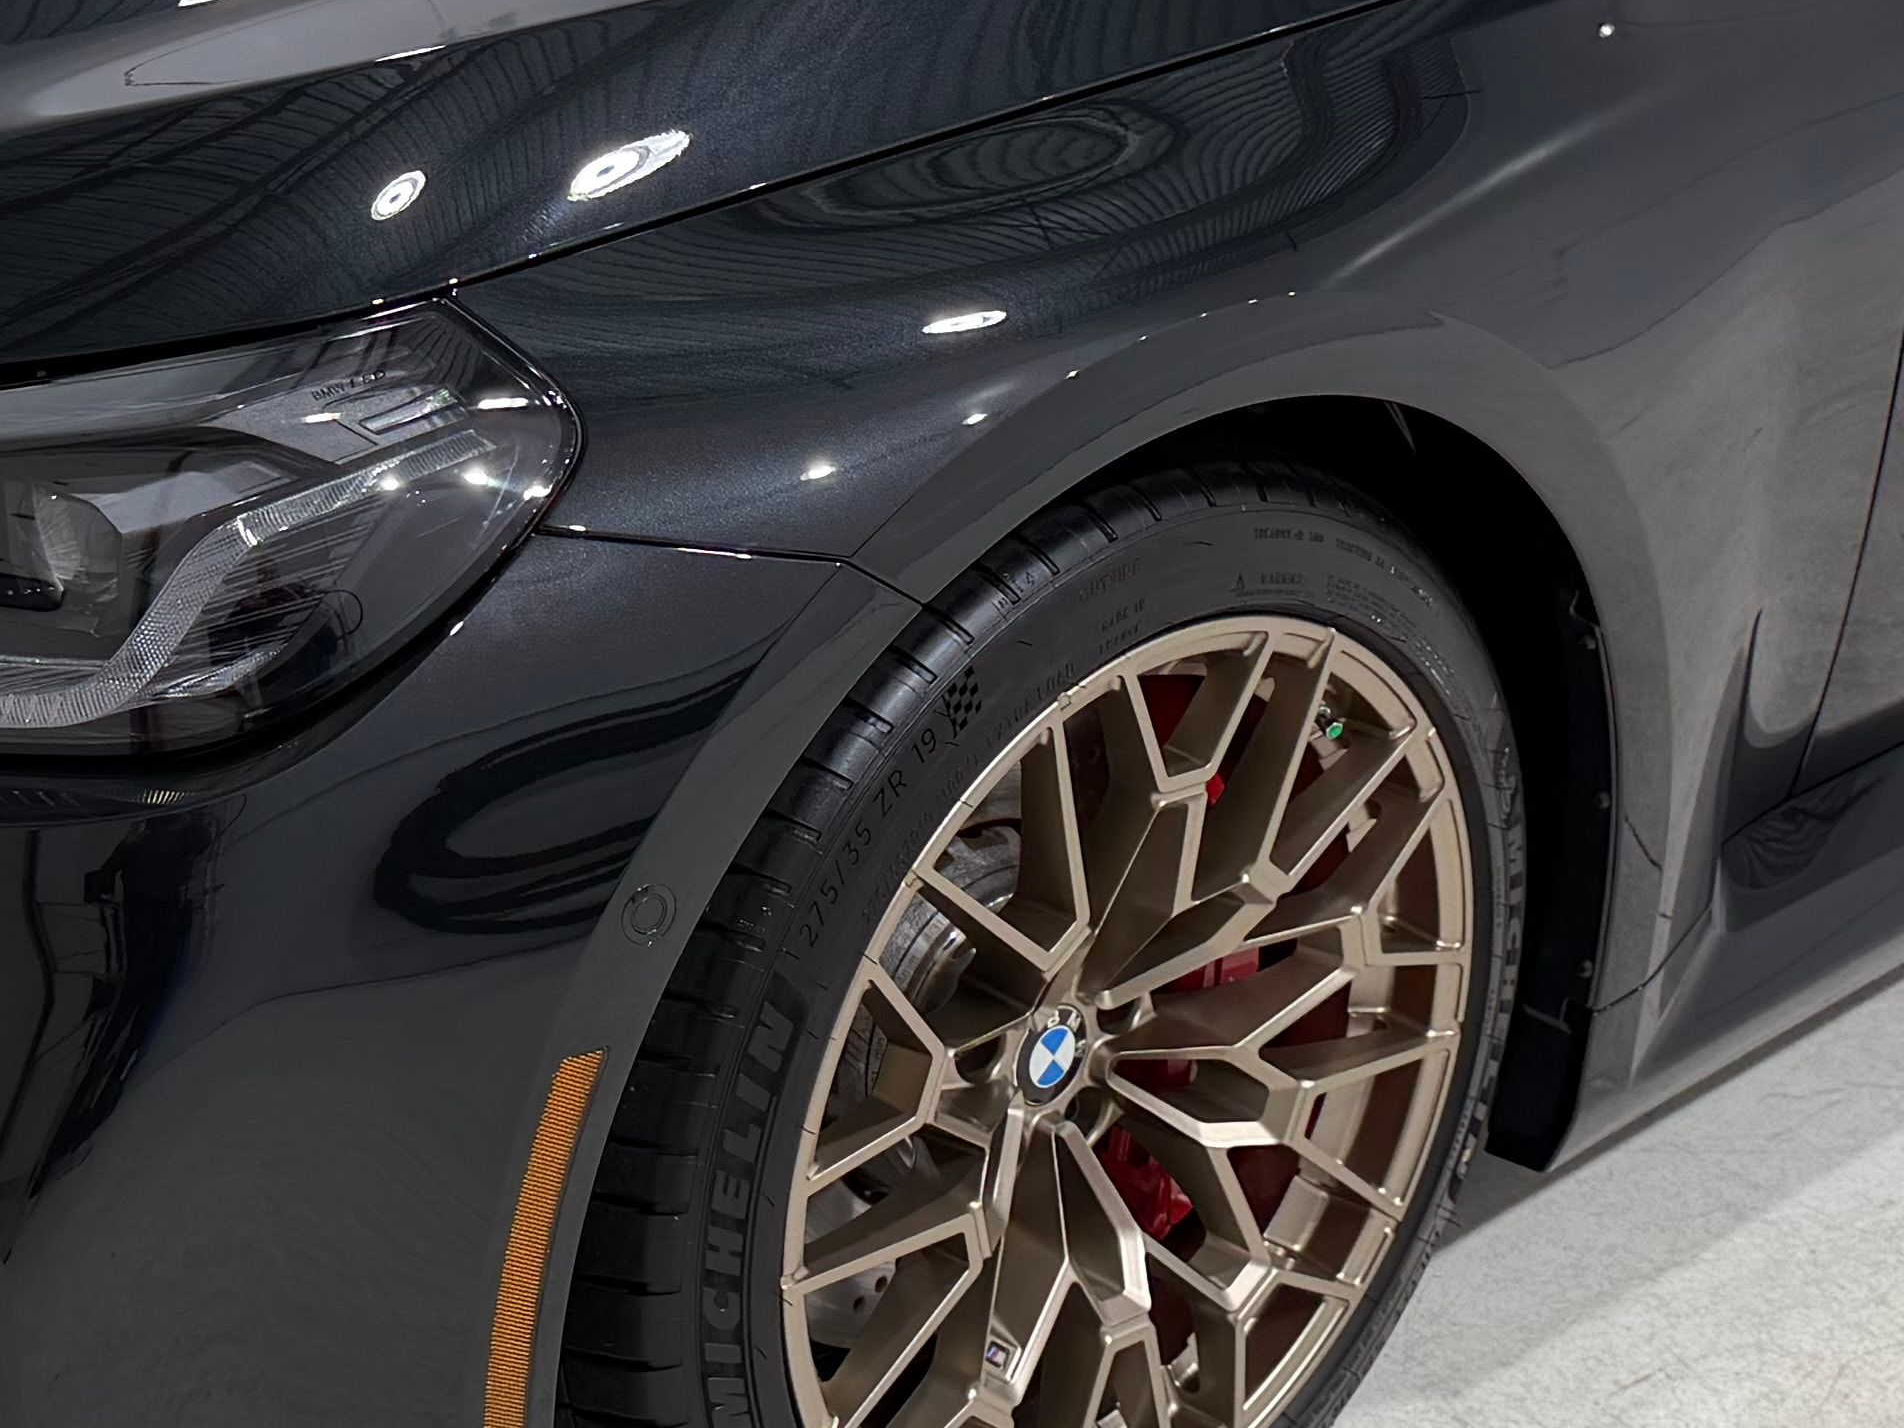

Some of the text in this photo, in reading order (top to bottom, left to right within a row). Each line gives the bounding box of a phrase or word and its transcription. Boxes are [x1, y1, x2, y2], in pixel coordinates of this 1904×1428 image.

[311, 383, 346, 401] BMW
[799, 822, 872, 948] 275/35
[872, 770, 908, 818] ZR
[911, 727, 938, 764] 19
